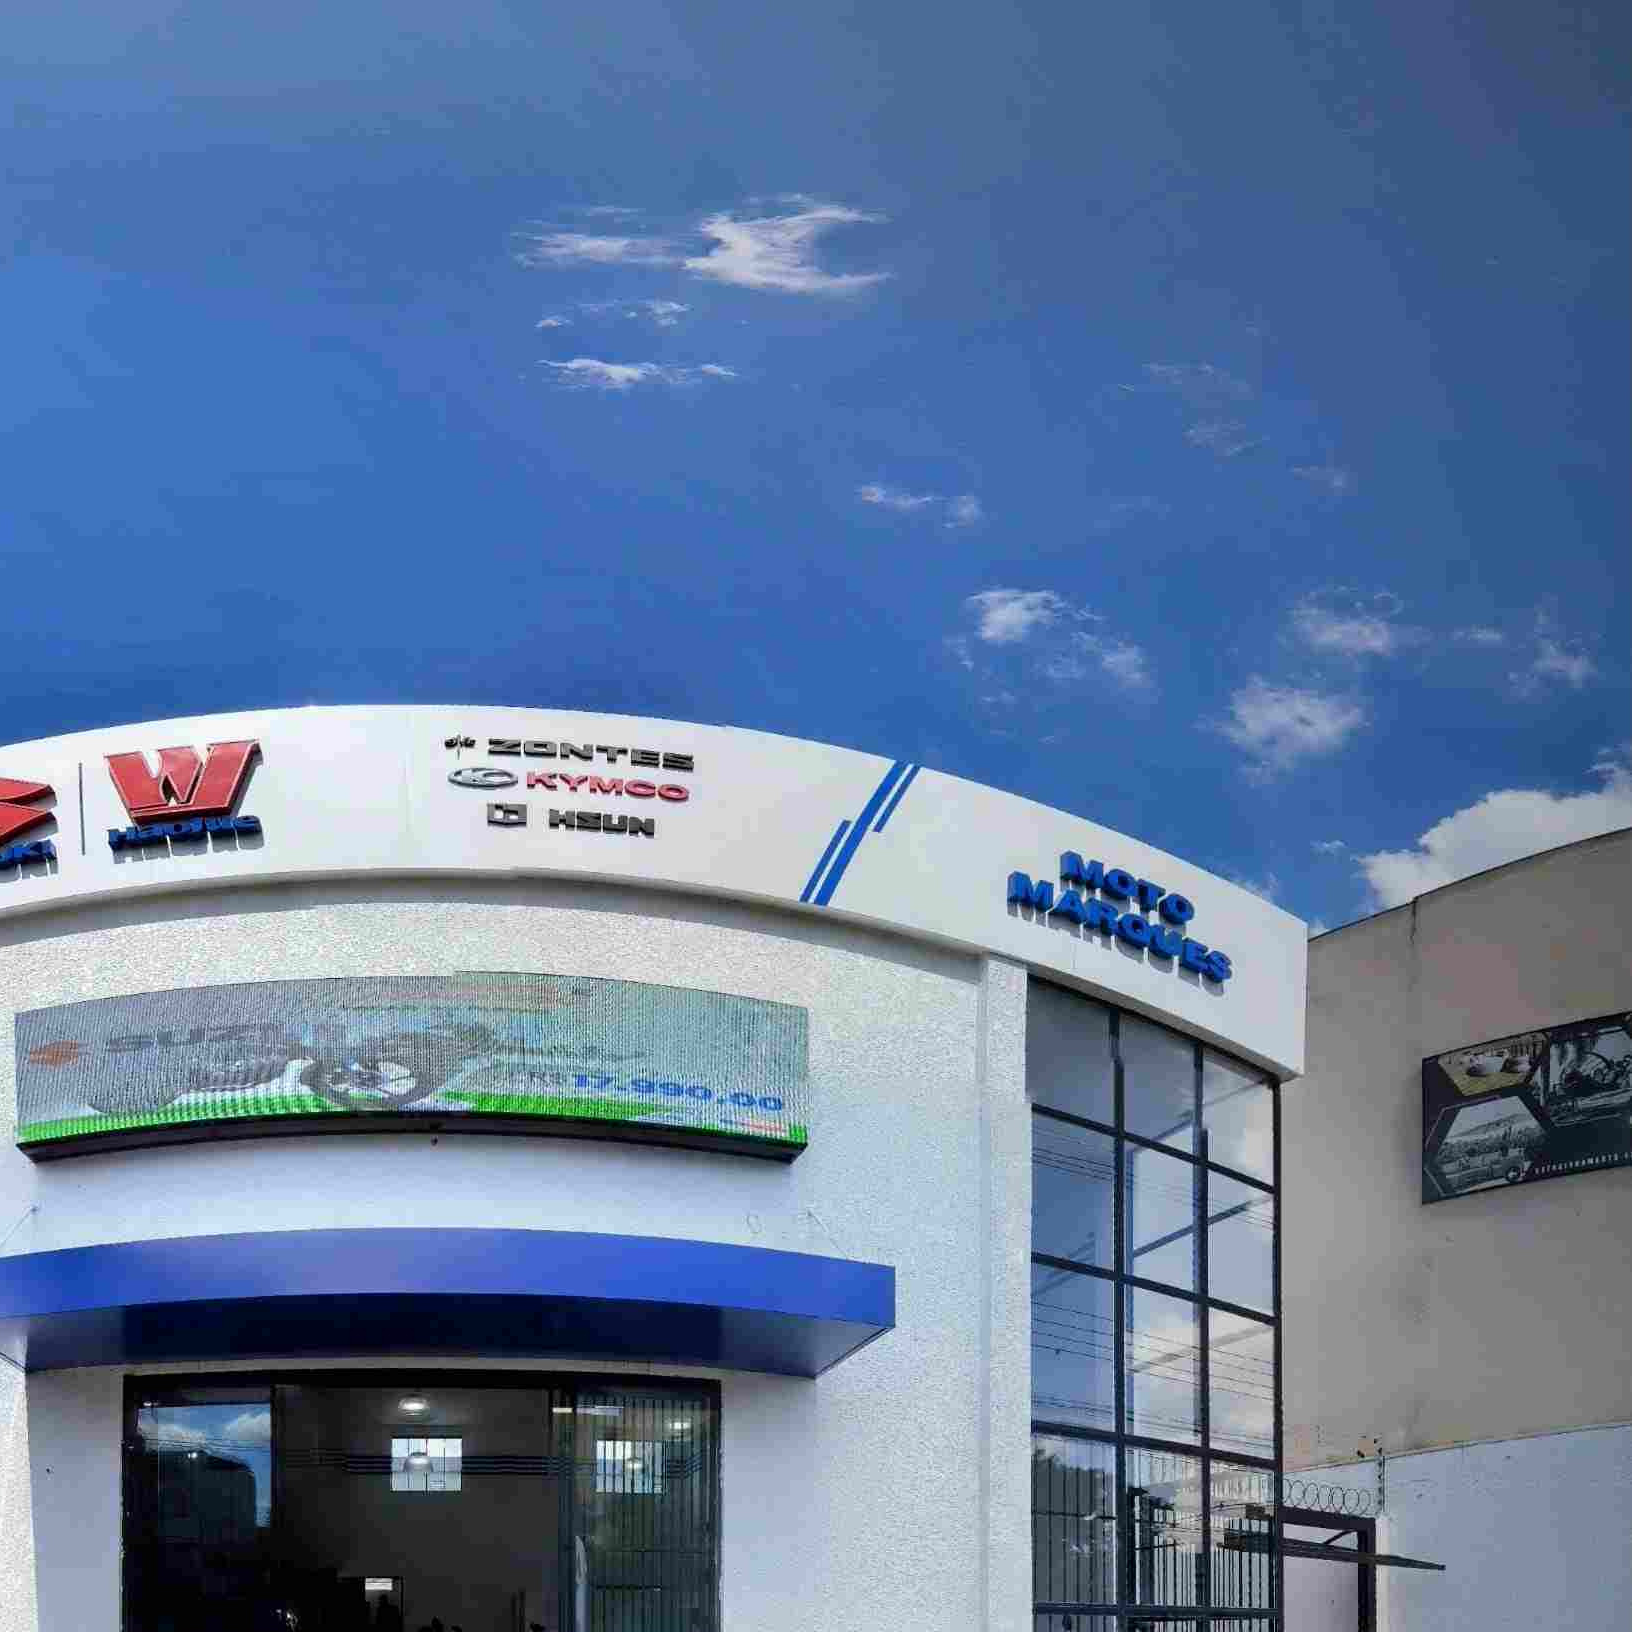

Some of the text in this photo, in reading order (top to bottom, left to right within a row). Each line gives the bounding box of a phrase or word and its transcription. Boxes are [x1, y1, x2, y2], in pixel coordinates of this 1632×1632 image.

[488, 738, 694, 772] ZONTES
[526, 771, 690, 802] KYMCO
[548, 808, 655, 839] HSUN
[1059, 850, 1195, 925] MOTO
[1006, 869, 1232, 983] MARQUES
